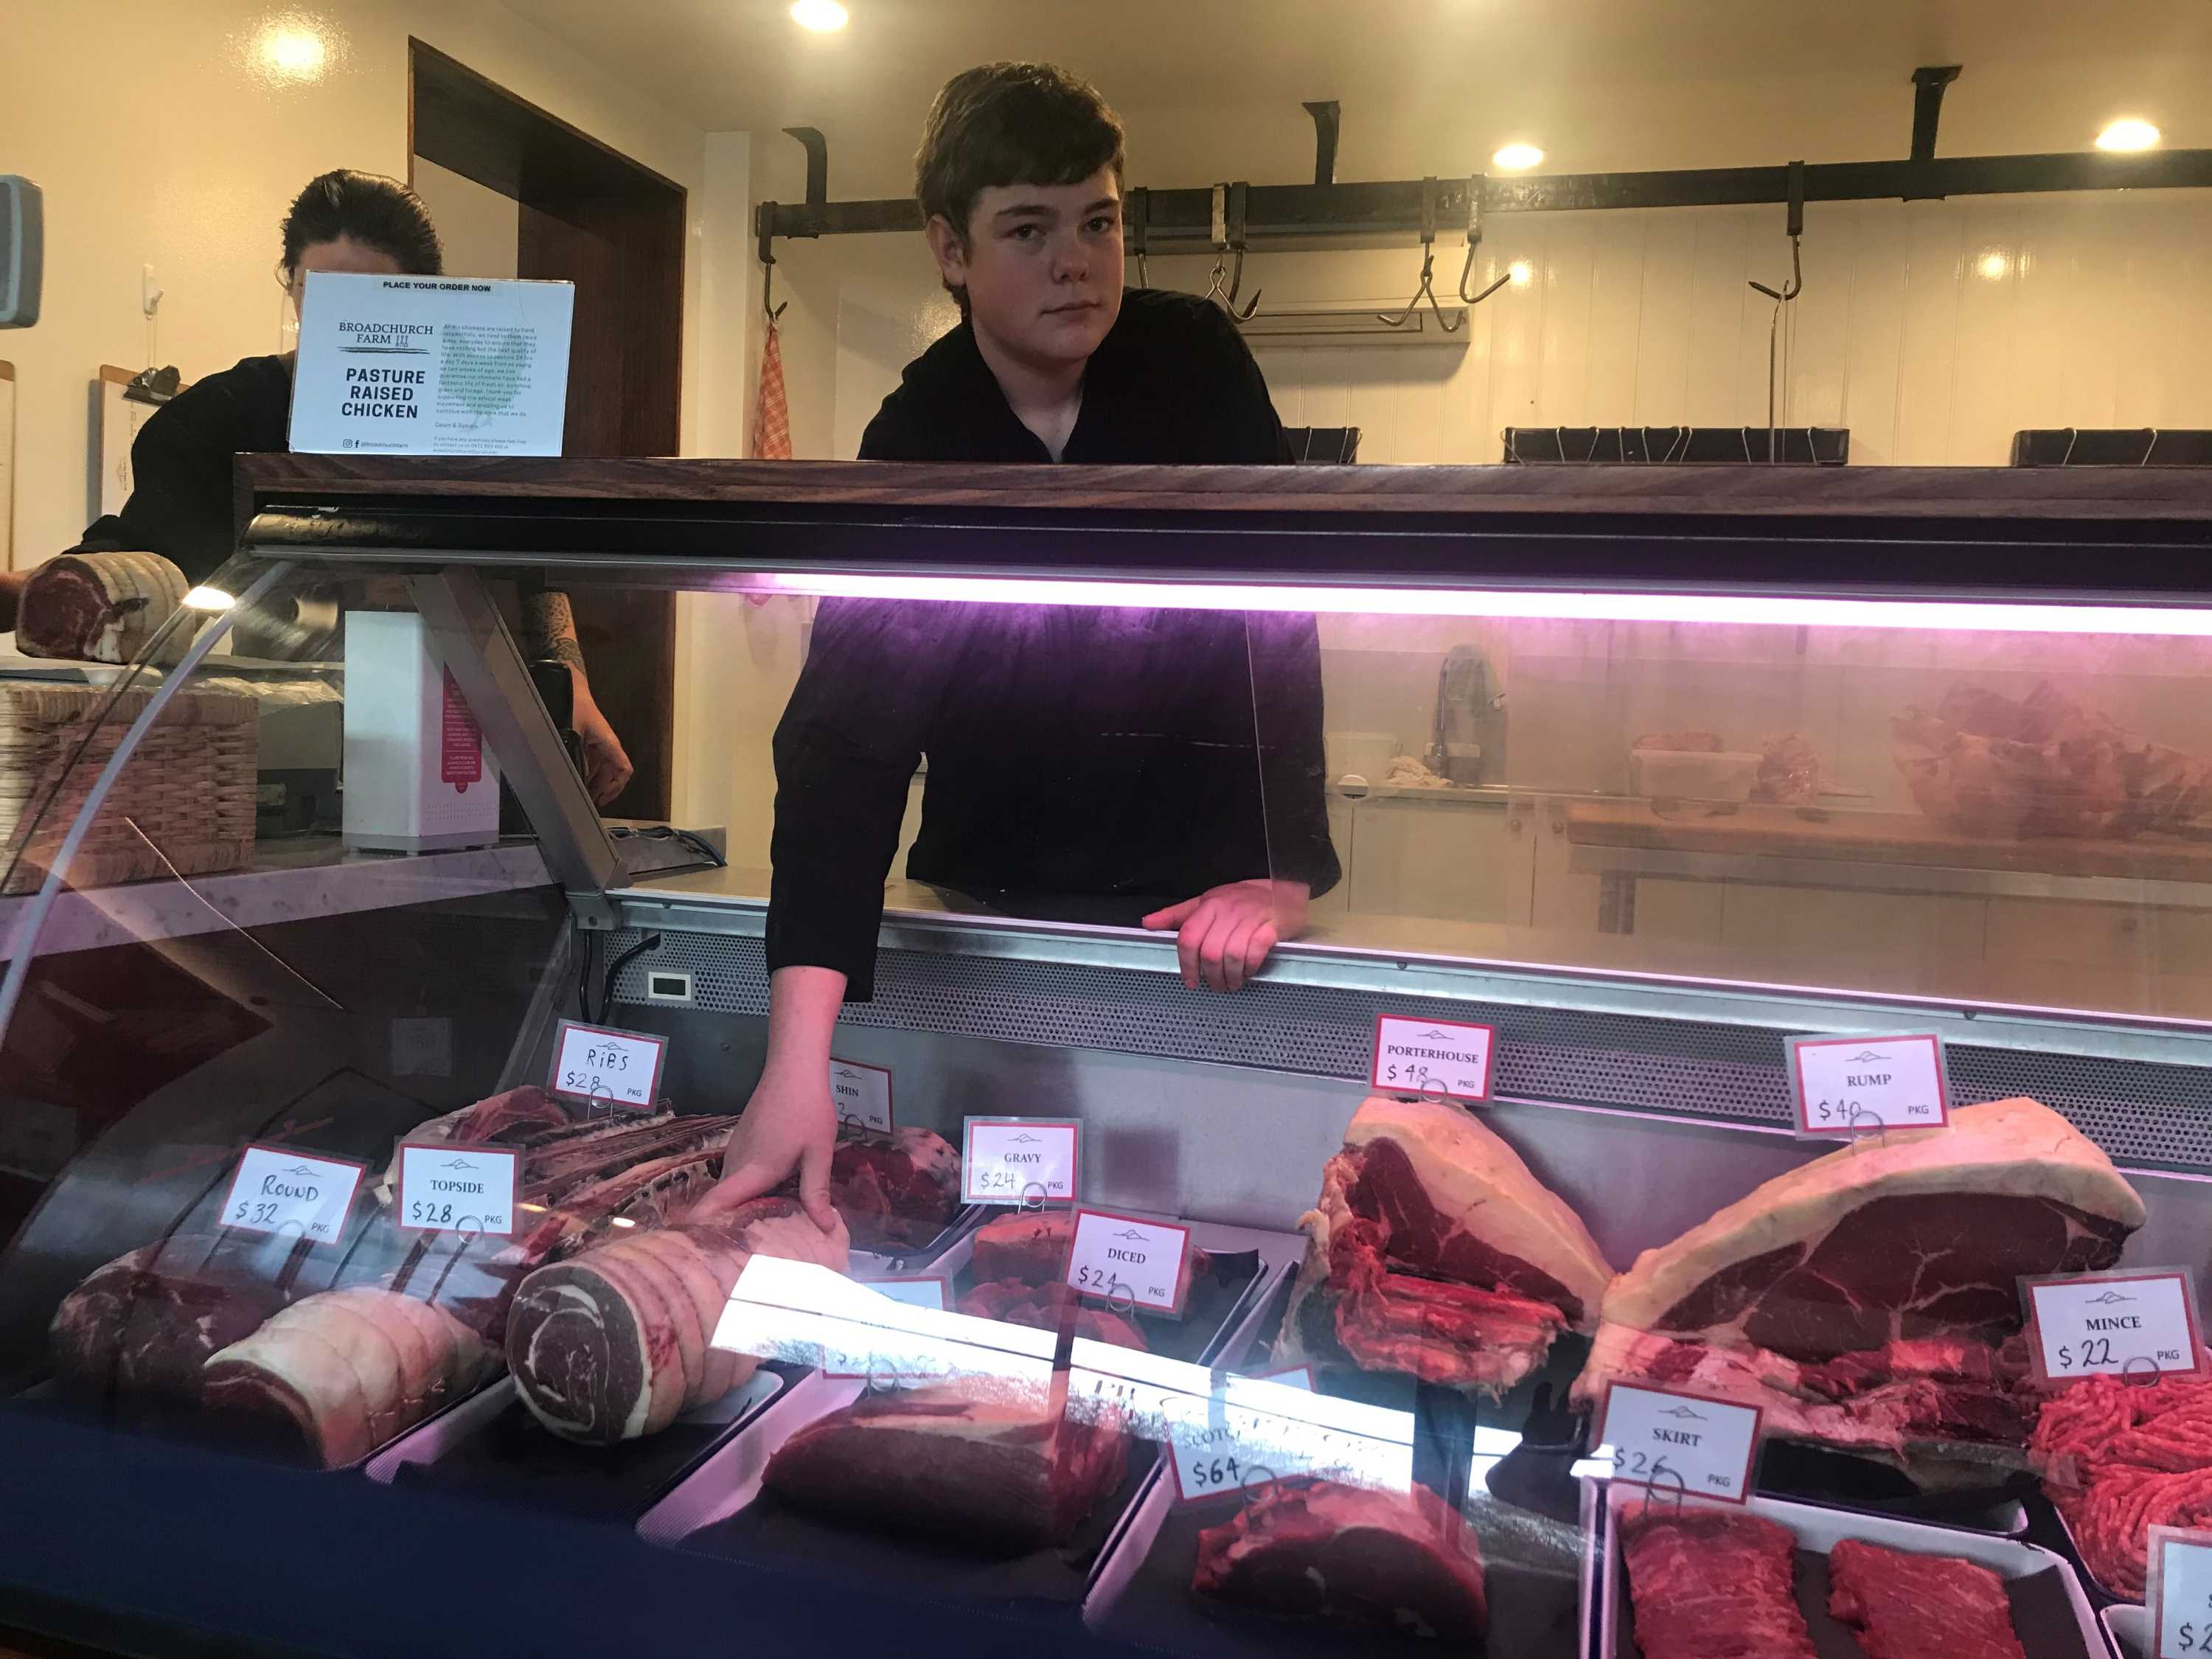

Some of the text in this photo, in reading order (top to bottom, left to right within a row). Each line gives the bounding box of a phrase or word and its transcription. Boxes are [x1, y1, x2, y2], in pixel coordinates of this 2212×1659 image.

[383, 281, 411, 289] PLACE
[439, 283, 470, 291] ORDER
[338, 321, 434, 335] BROADCHURCH
[356, 334, 392, 344] FARM
[346, 367, 425, 384] PASTURE
[350, 385, 414, 401] RAISED
[341, 402, 418, 418] CHICKEN
[1387, 1044, 1479, 1063] PORTERHOUSE
[566, 1070, 643, 1097] $28 PKG
[1458, 1079, 1475, 1088] PKG
[1847, 1074, 1892, 1087] RUMP
[836, 1084, 859, 1097] SHIN
[1818, 1099, 1930, 1121] $40 PKG
[1004, 1152, 1042, 1163] GRAVY
[260, 1174, 319, 1202] ROUND
[431, 1180, 484, 1194] TOPSIDE
[981, 1172, 1063, 1189] $24 PKG
[412, 1200, 502, 1224] $28 PKG
[311, 1222, 330, 1234] PKG
[1107, 1248, 1147, 1264] DICED
[1148, 1286, 1166, 1297] PKG
[2086, 1316, 2141, 1331] MINCE
[2157, 1349, 2180, 1360] PKG
[1652, 1427, 1703, 1447] SKIRT
[1193, 1457, 1241, 1488] $64
[1707, 1473, 1731, 1487] PKG
